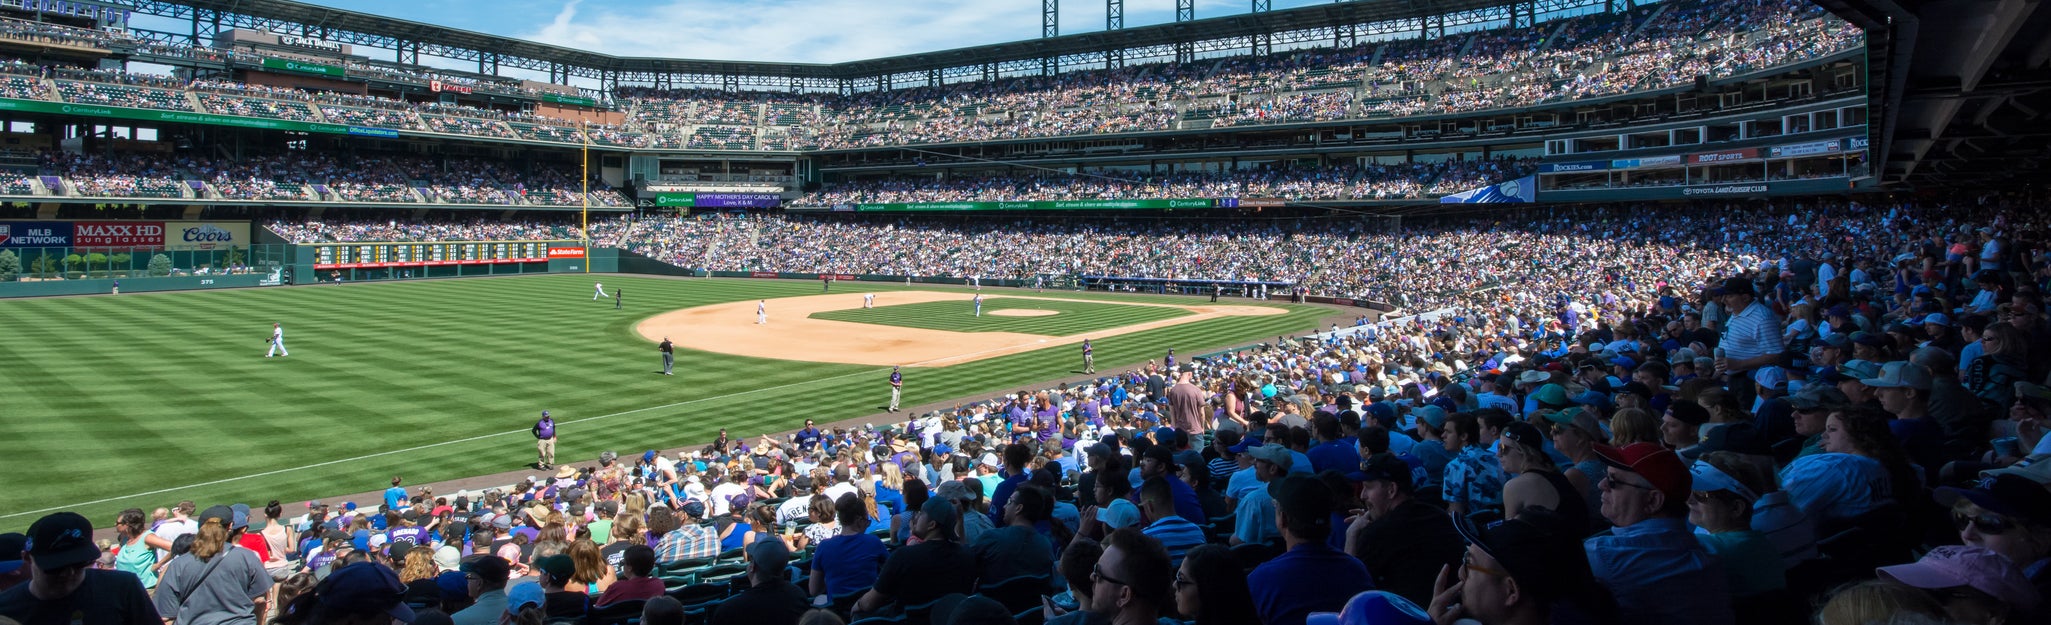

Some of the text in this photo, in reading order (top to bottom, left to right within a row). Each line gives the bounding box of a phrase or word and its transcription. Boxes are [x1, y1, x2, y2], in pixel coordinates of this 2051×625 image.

[73, 106, 111, 115] CenturyLink
[1698, 153, 1744, 162] ROOT SPORTS
[28, 228, 52, 236] MLB
[76, 225, 162, 236] MAXX HD
[182, 227, 233, 242] Coors
[11, 236, 66, 244] NETWORK
[76, 236, 161, 244] sunglasses
